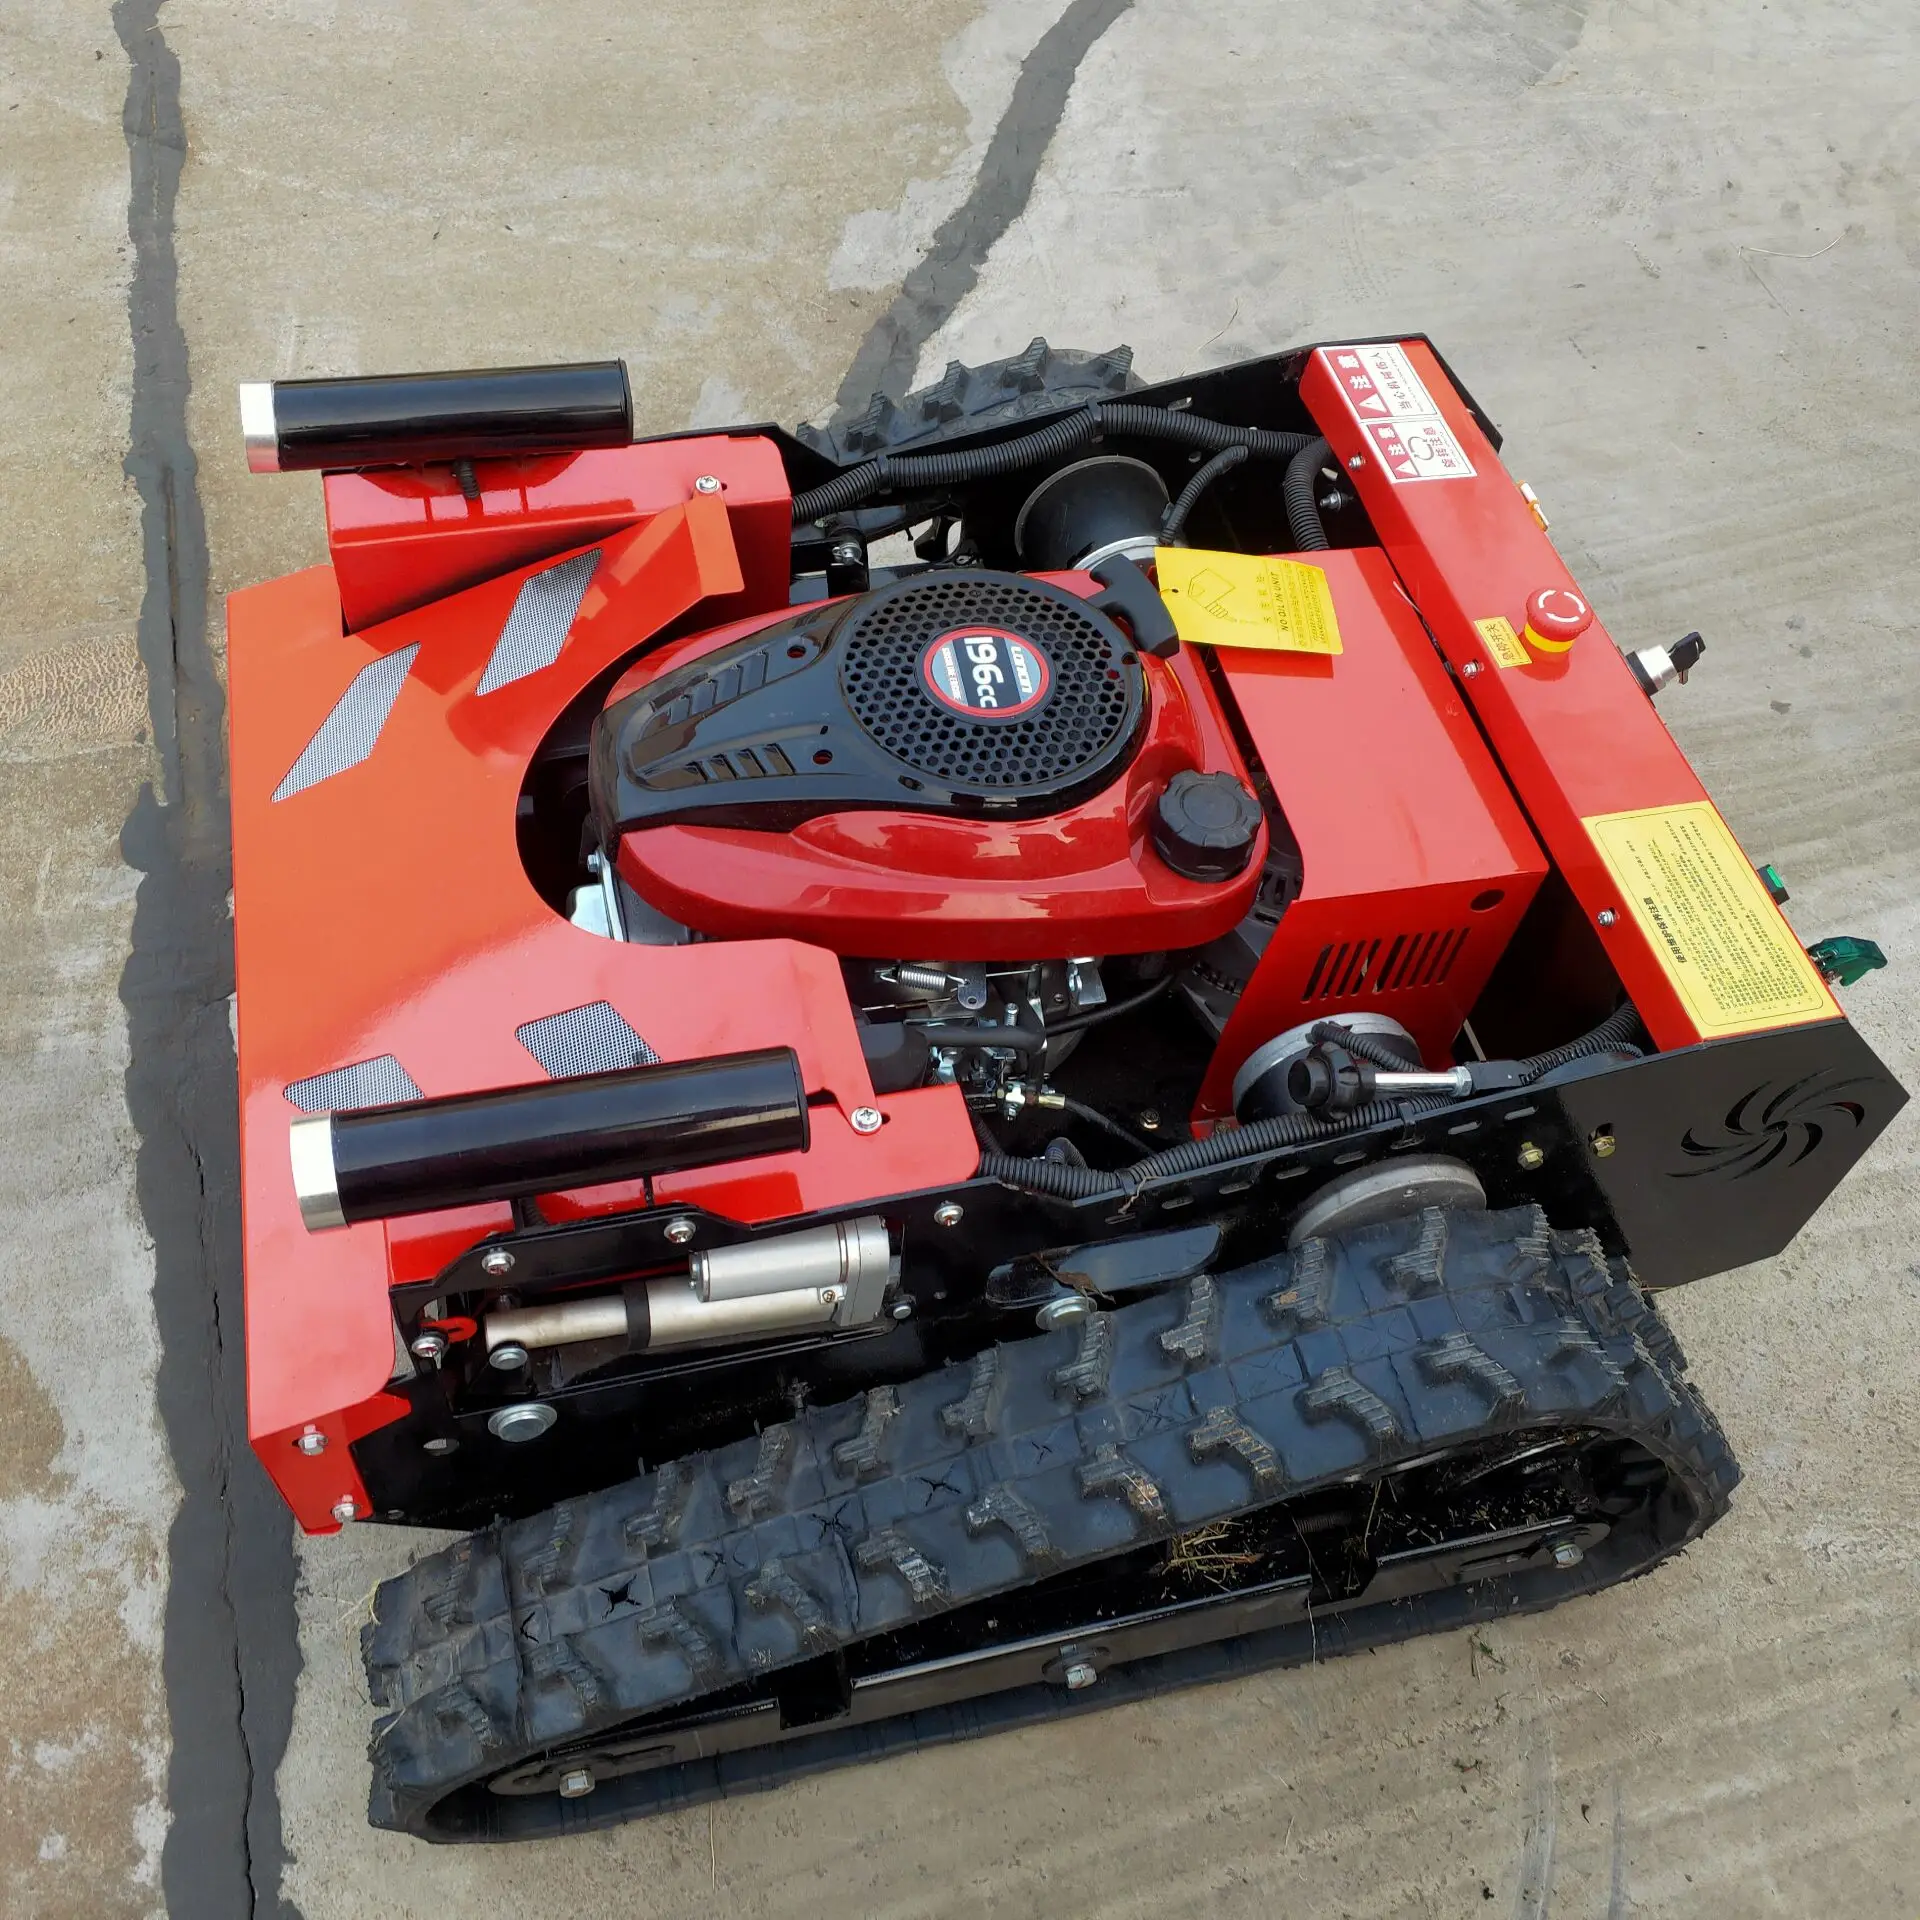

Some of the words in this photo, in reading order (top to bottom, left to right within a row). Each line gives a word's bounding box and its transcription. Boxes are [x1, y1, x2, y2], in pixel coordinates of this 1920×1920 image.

[1336, 354, 1372, 390] 注意
[1377, 426, 1406, 457] 注意
[1270, 571, 1282, 591] UNIT
[1279, 619, 1289, 632] NO
[963, 636, 1005, 708] 196cc
[1643, 897, 1688, 964] 使用维护保养注意
